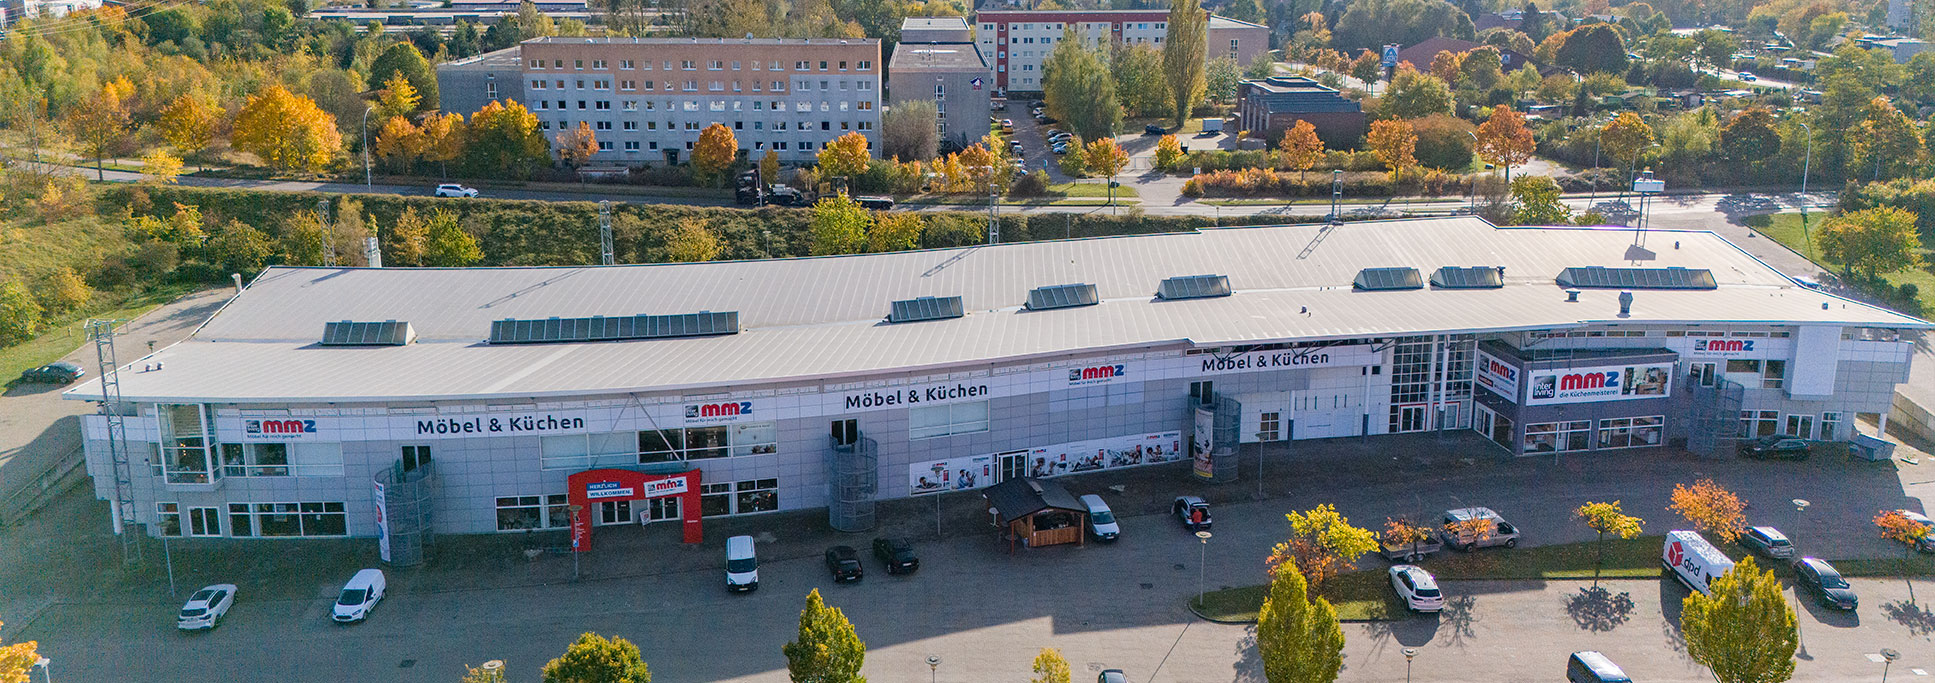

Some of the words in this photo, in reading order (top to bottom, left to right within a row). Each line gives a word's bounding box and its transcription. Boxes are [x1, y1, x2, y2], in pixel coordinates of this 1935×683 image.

[1708, 340, 1754, 351] mmz
[1202, 355, 1251, 372] Möbel
[1256, 355, 1267, 367] &
[1272, 353, 1329, 366] Küchen
[1490, 359, 1515, 381] mmz
[1082, 365, 1124, 379] mmz
[1535, 382, 1552, 390] inter
[1560, 371, 1619, 390] mmz
[846, 390, 902, 409] Möbel
[908, 390, 920, 403] &
[926, 384, 988, 401] Küchen
[1534, 388, 1554, 397] living
[1570, 389, 1618, 398] Küchenmeisterei
[701, 401, 752, 417] mmz
[263, 420, 317, 433] mmz
[417, 418, 482, 434] Möbel
[489, 418, 503, 432] &
[509, 415, 584, 431] Küchen
[656, 480, 684, 490] mmz
[1684, 557, 1701, 577] dpd
